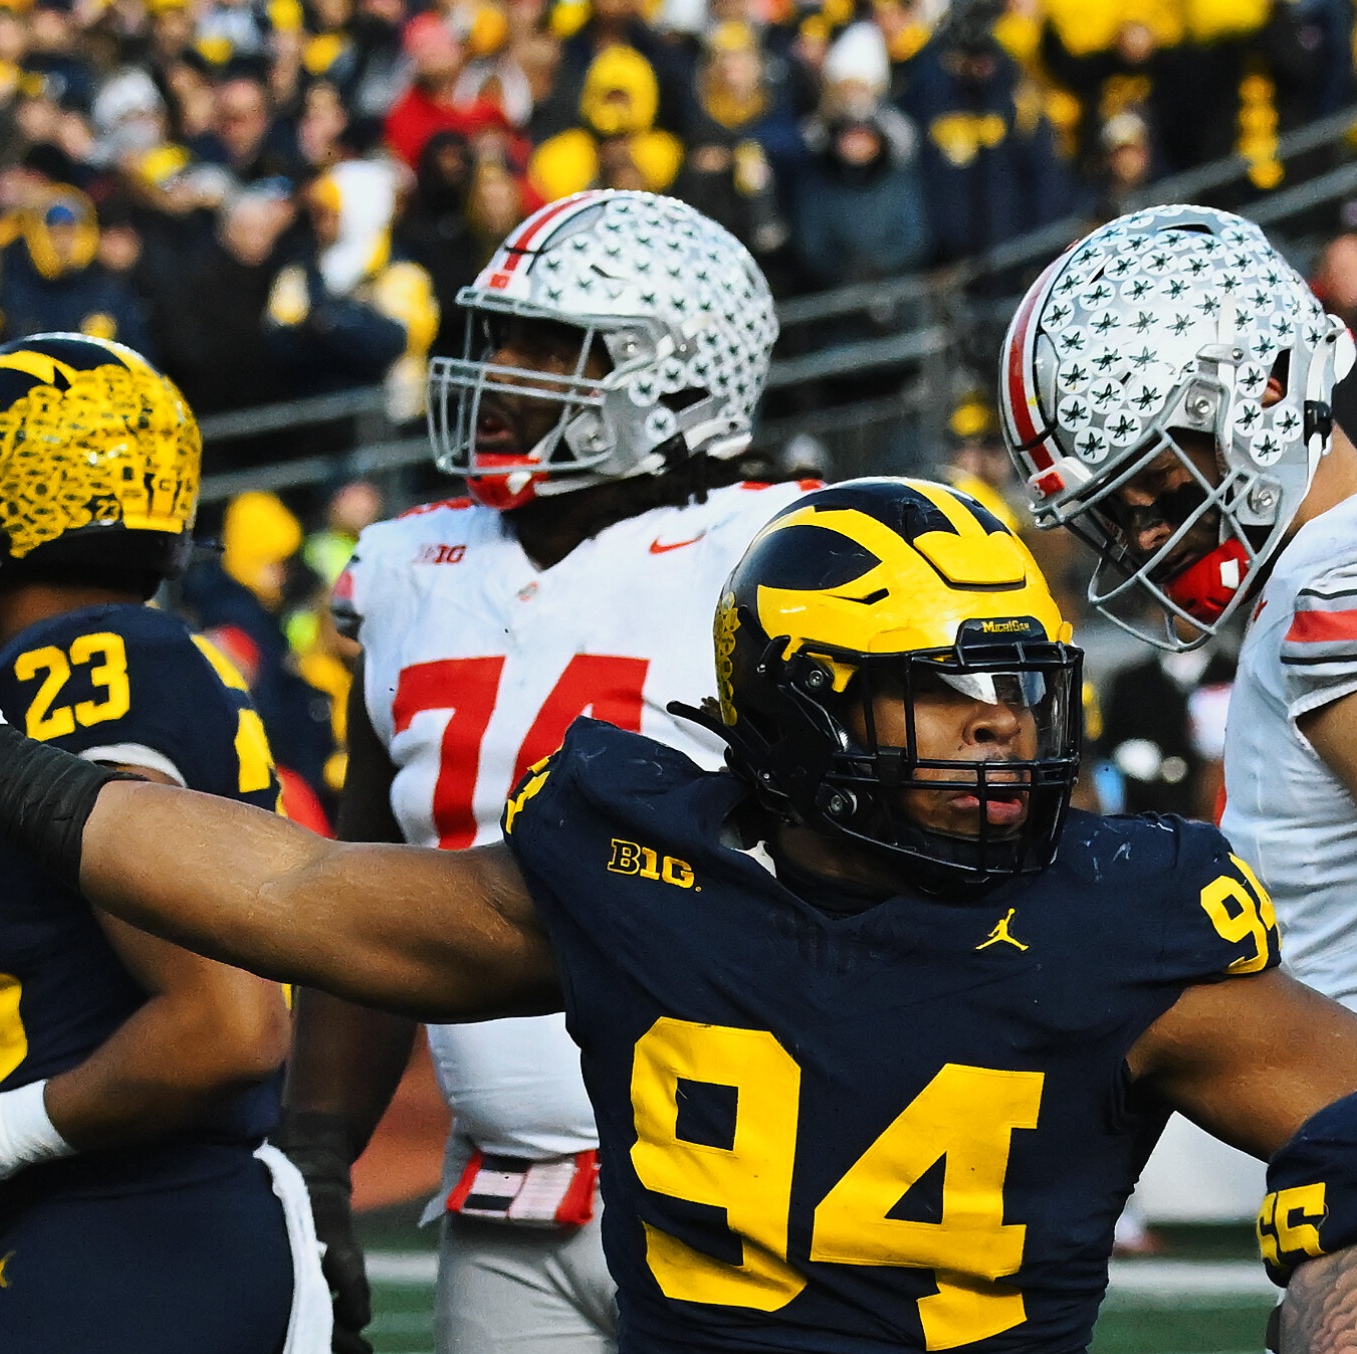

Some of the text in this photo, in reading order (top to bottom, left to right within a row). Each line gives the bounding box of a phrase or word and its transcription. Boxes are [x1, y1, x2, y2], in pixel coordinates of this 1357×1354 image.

[13, 631, 132, 742] 23
[392, 653, 650, 850] 74
[607, 838, 696, 889] B1G
[630, 1015, 1045, 1353] 94
